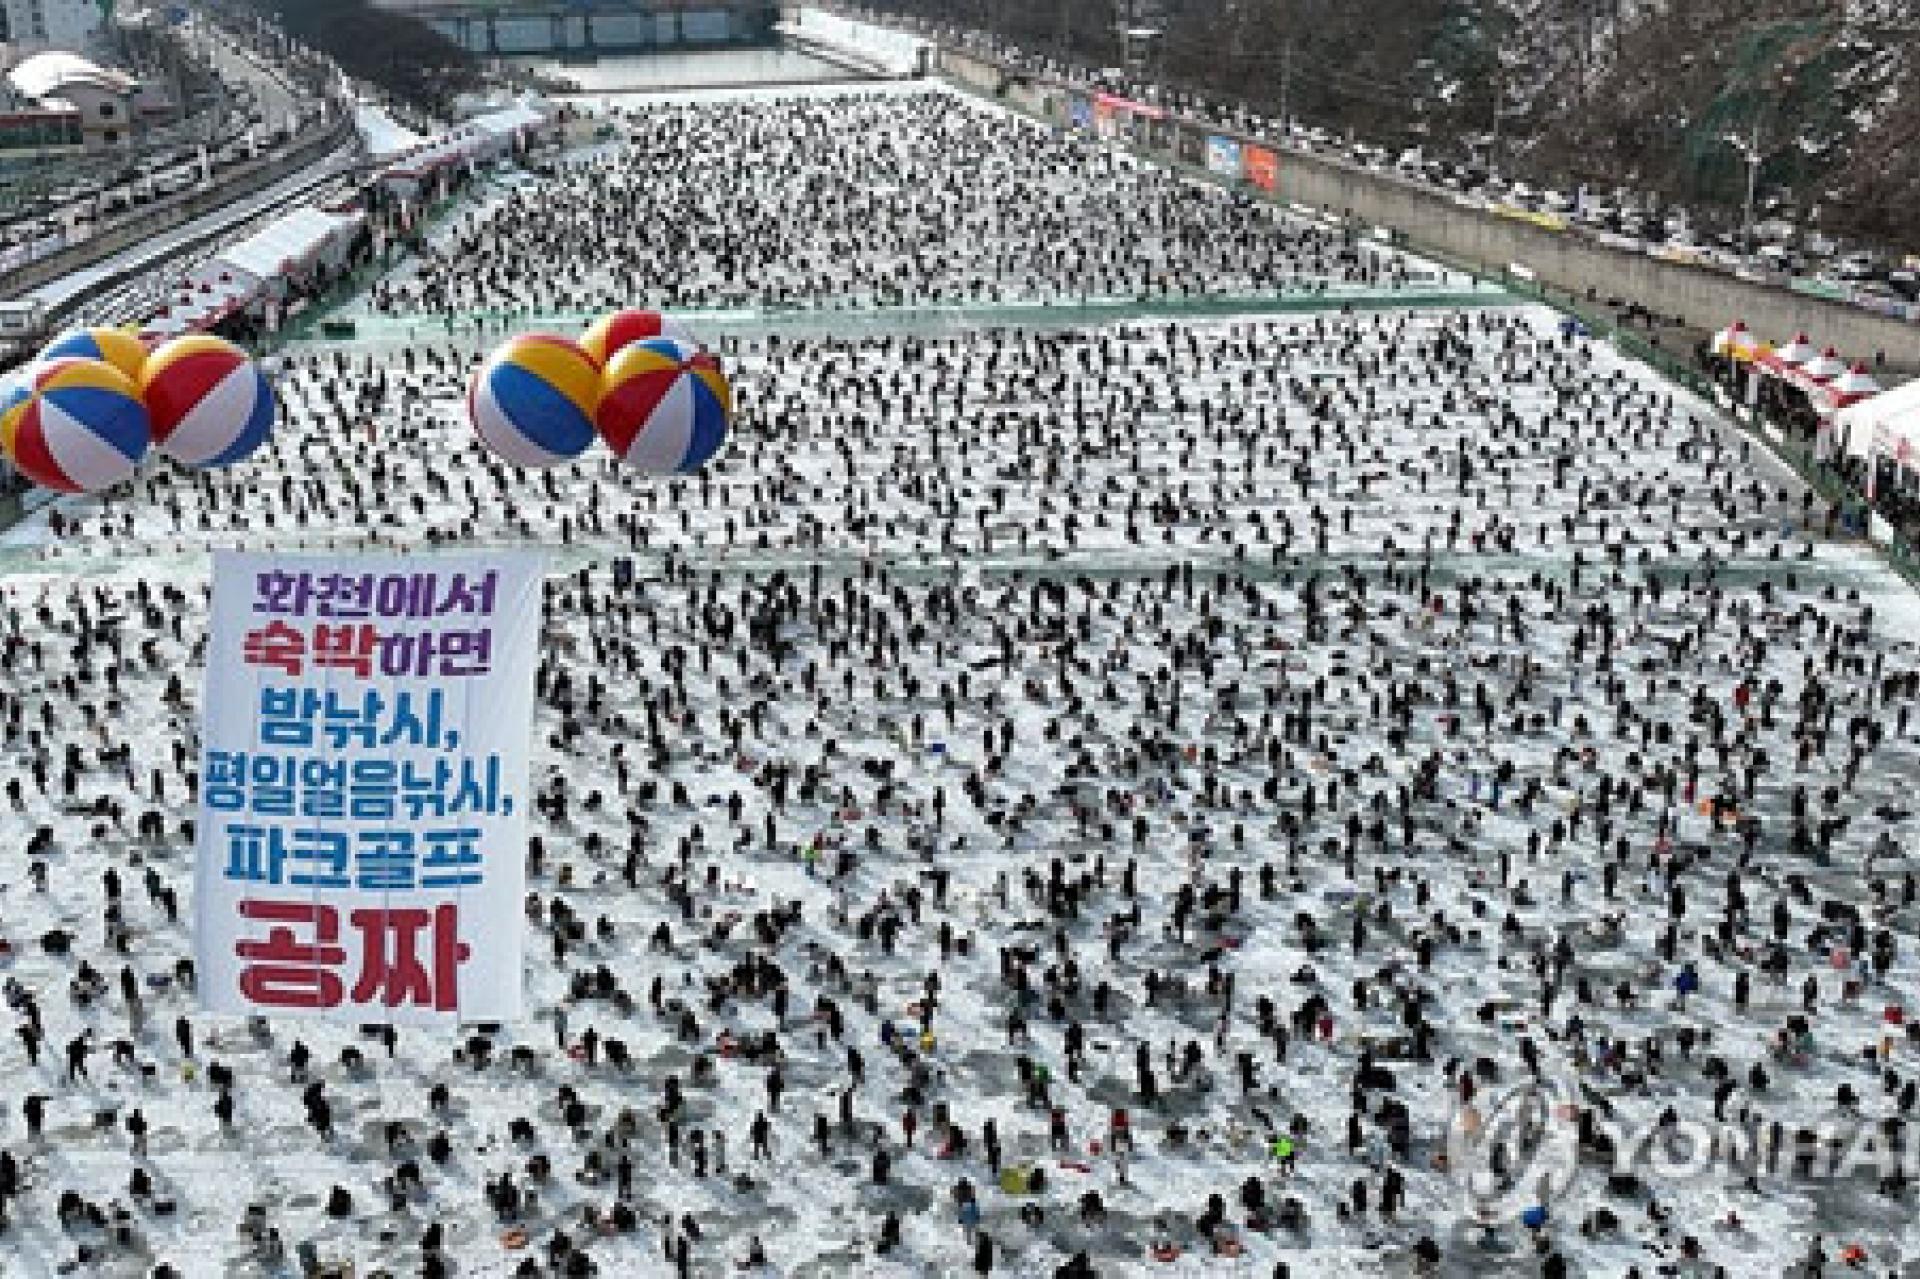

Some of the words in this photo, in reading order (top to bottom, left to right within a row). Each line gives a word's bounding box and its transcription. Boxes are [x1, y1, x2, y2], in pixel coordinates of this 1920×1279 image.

[252, 570, 497, 617] 화천에서
[243, 620, 492, 678] 숙박하면
[260, 687, 459, 749] 밤낚시,
[205, 751, 513, 819] 평일얼음낚시,
[222, 824, 484, 890] 파크골프
[235, 900, 471, 1012] 공짜
